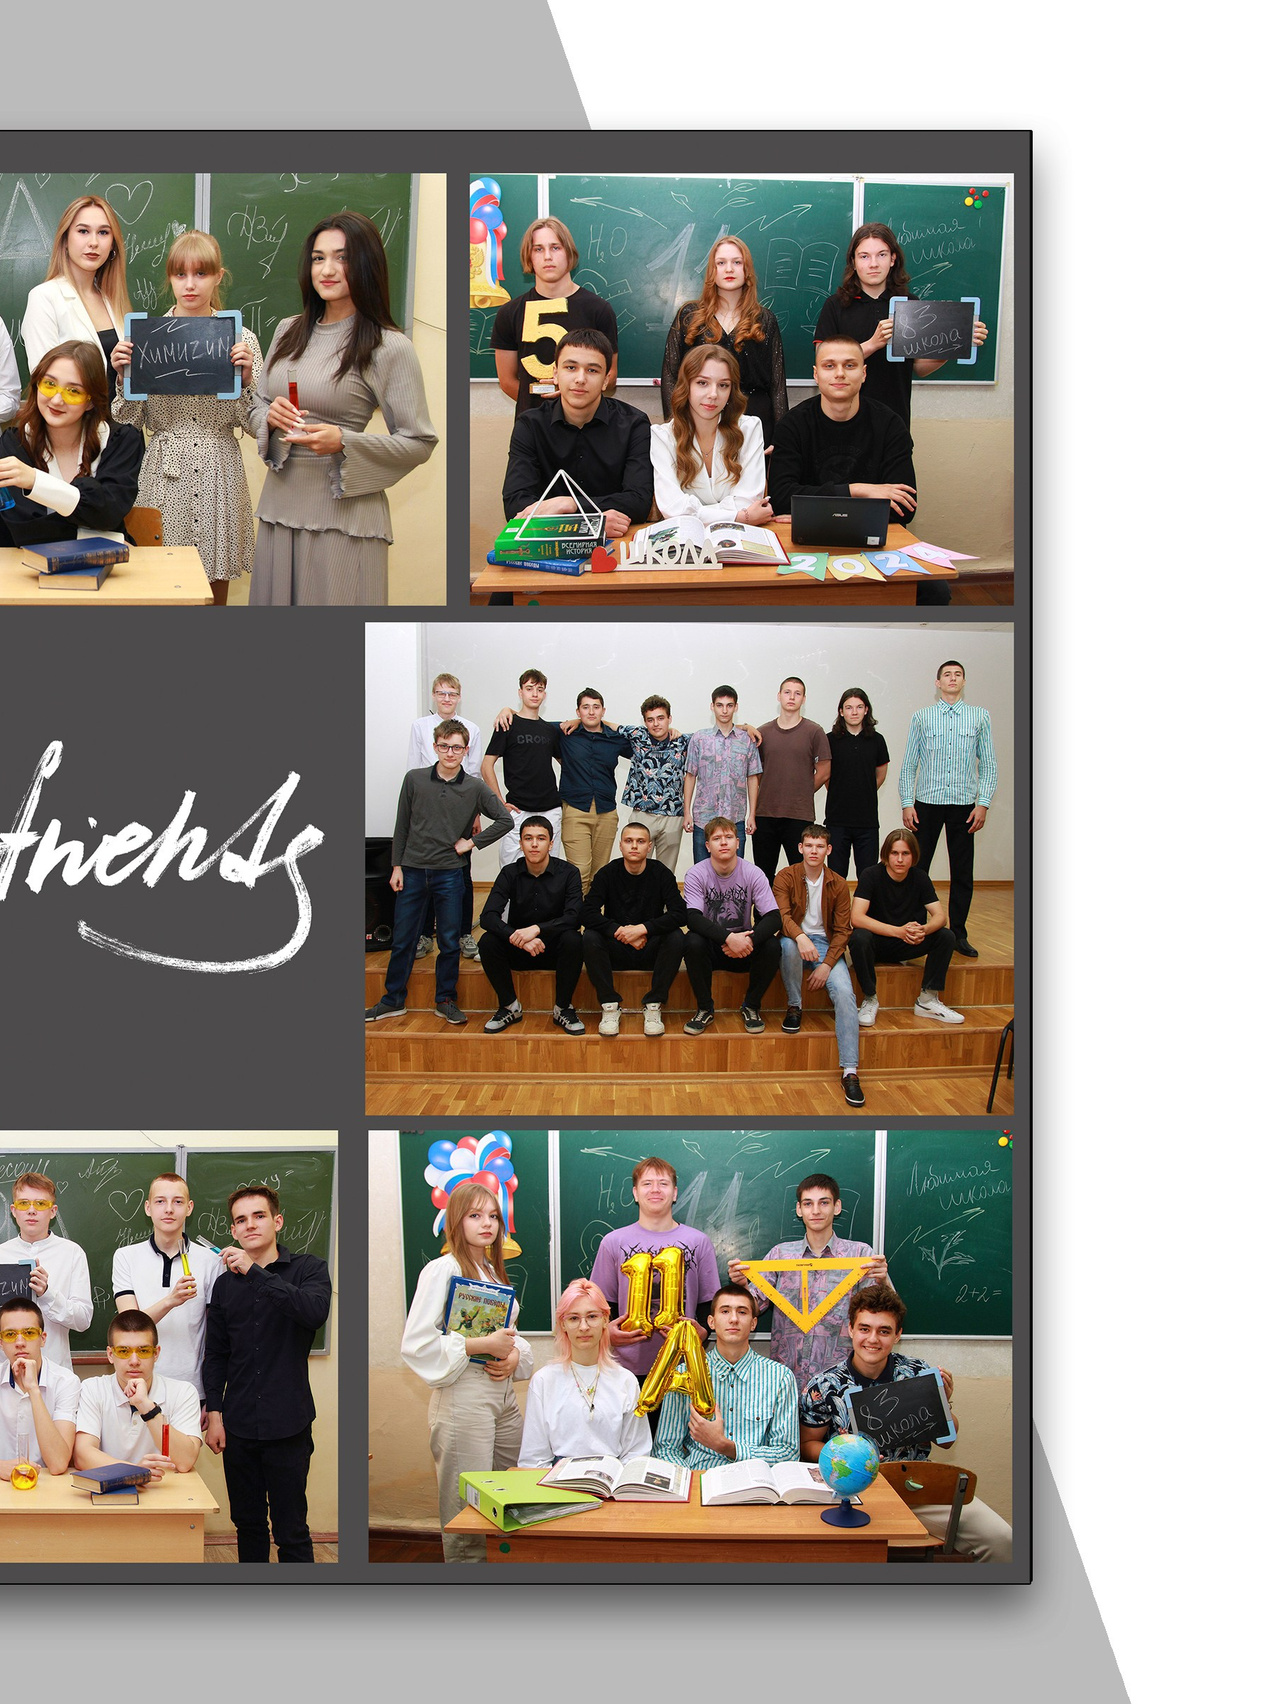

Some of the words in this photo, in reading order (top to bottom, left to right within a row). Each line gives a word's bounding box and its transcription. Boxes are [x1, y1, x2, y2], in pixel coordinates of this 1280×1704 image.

[520, 297, 568, 379] 5
[899, 304, 938, 339] 83
[561, 541, 598, 549] ВСЕМИРНАЯ
[620, 538, 719, 566] ШКОЛА
[860, 1388, 900, 1430] 83
